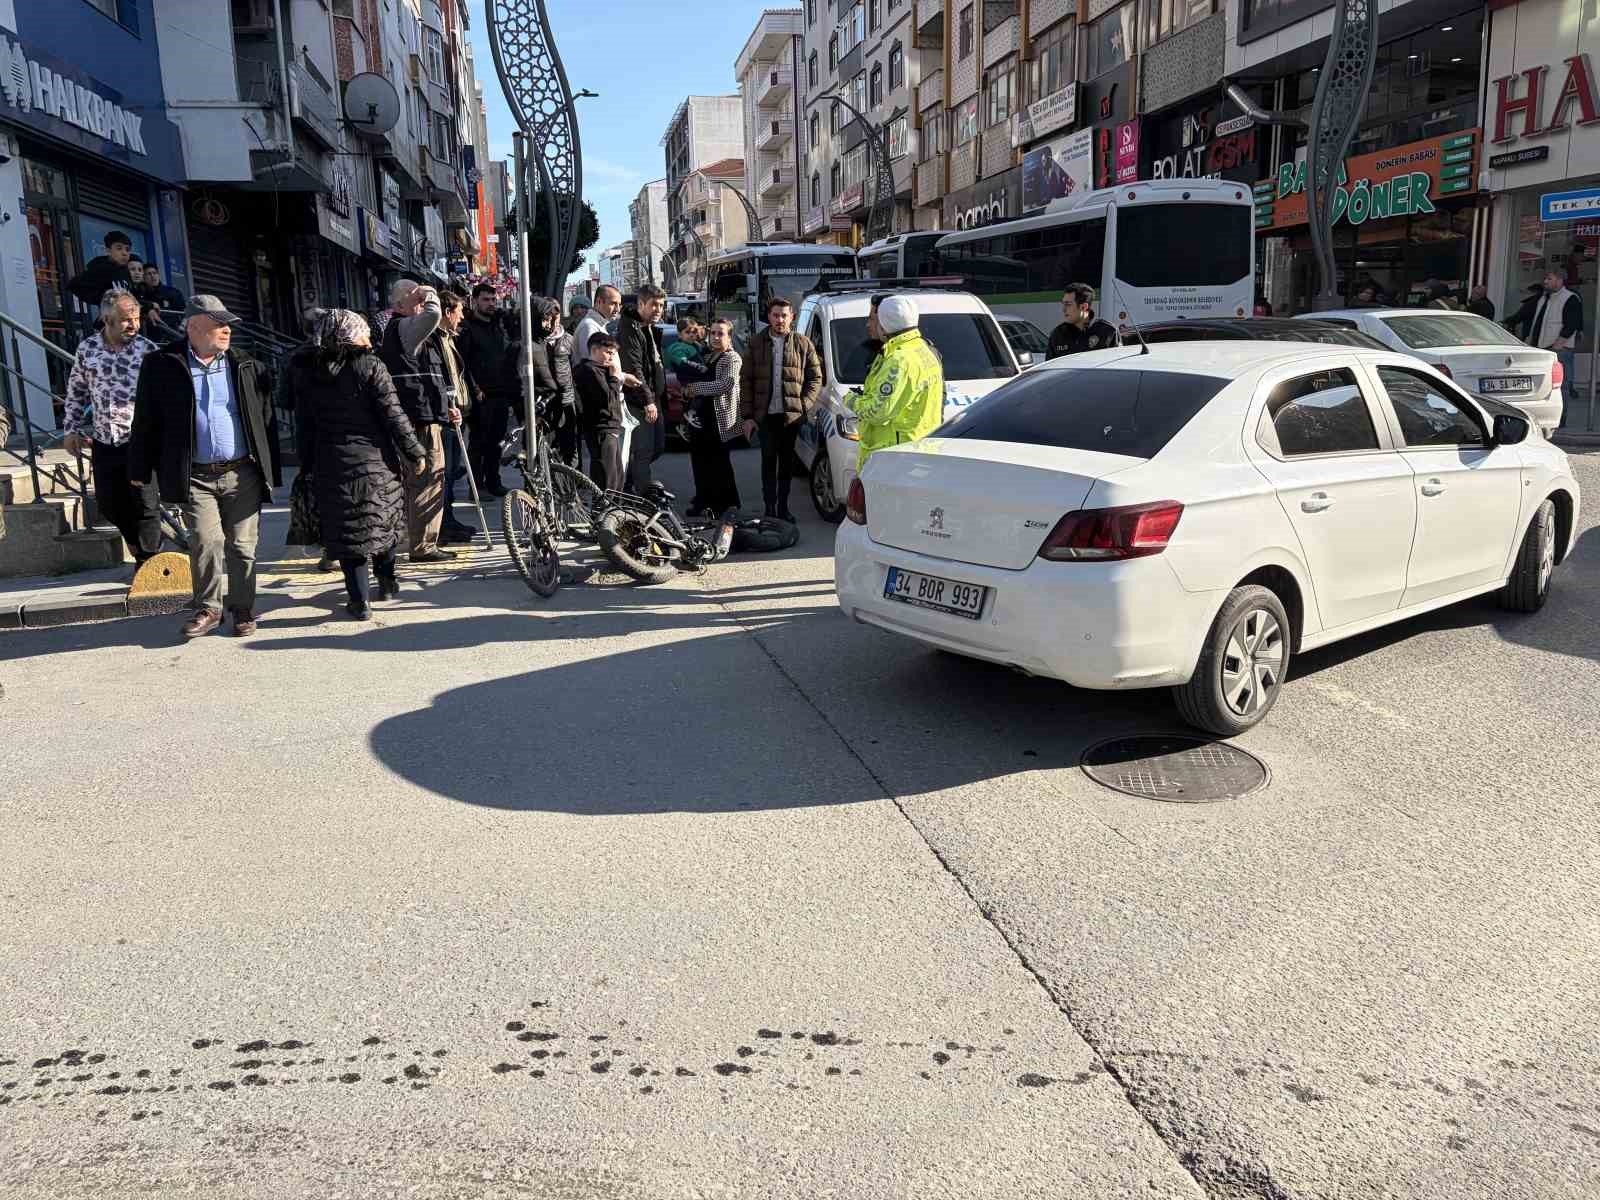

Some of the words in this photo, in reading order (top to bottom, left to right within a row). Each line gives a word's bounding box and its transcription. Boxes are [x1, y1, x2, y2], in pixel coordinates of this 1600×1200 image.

[28, 60, 147, 156] HALKBANK
[1153, 145, 1206, 180] POLAT
[1207, 131, 1257, 170] GSM
[1331, 171, 1436, 226] DÖNER
[1551, 201, 1579, 212] TEK
[896, 573, 911, 595] 34
[918, 578, 945, 602] BOR
[952, 585, 979, 609] 993
